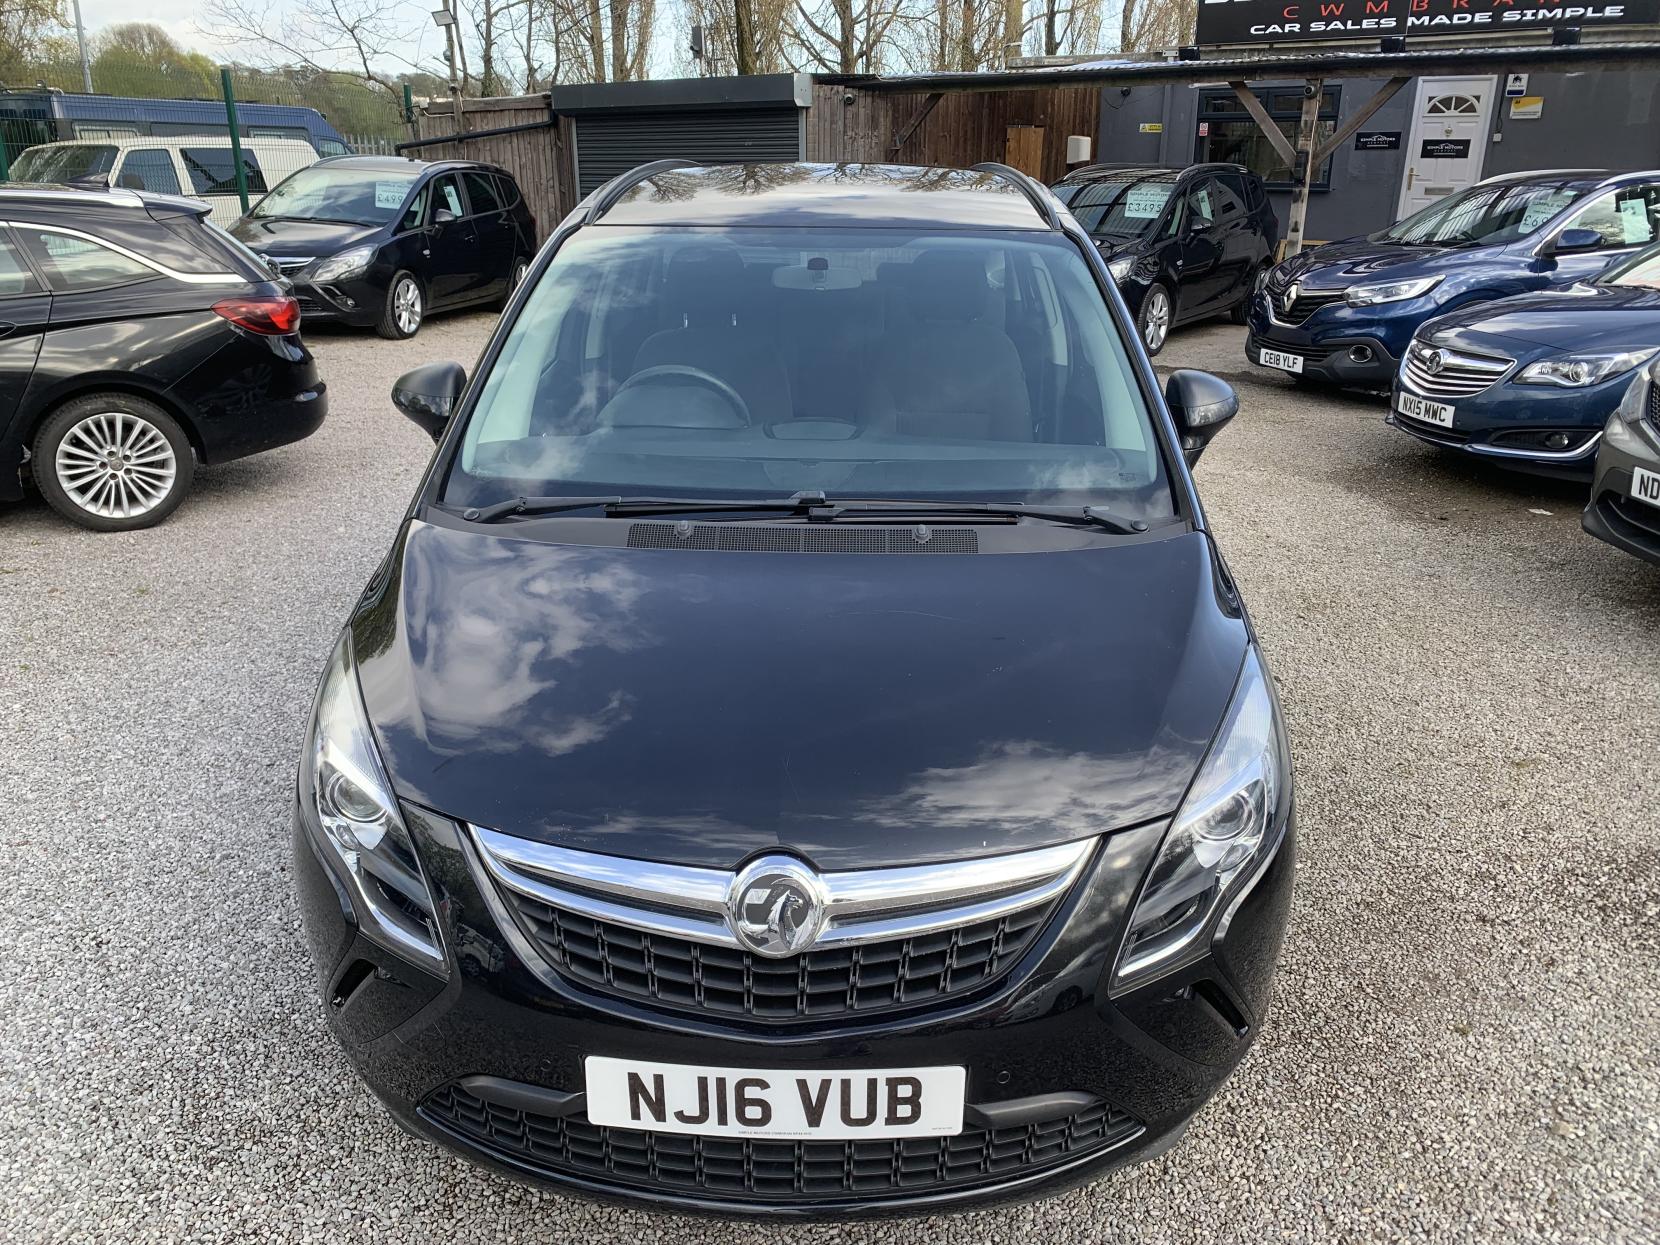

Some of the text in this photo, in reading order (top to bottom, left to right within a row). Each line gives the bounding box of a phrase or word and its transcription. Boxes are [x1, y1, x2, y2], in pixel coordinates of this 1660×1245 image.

[1250, 5, 1625, 35] CAR SALES MADE SIMPLE
[1283, 0, 1560, 18] CWMBRA
[378, 194, 402, 203] £499
[1128, 203, 1161, 212] £3495
[1263, 352, 1299, 369] CE18 YLF
[1402, 396, 1448, 423] NX15 MWC
[1638, 473, 1660, 500] ND
[627, 1071, 923, 1128] NJ16 VUB
